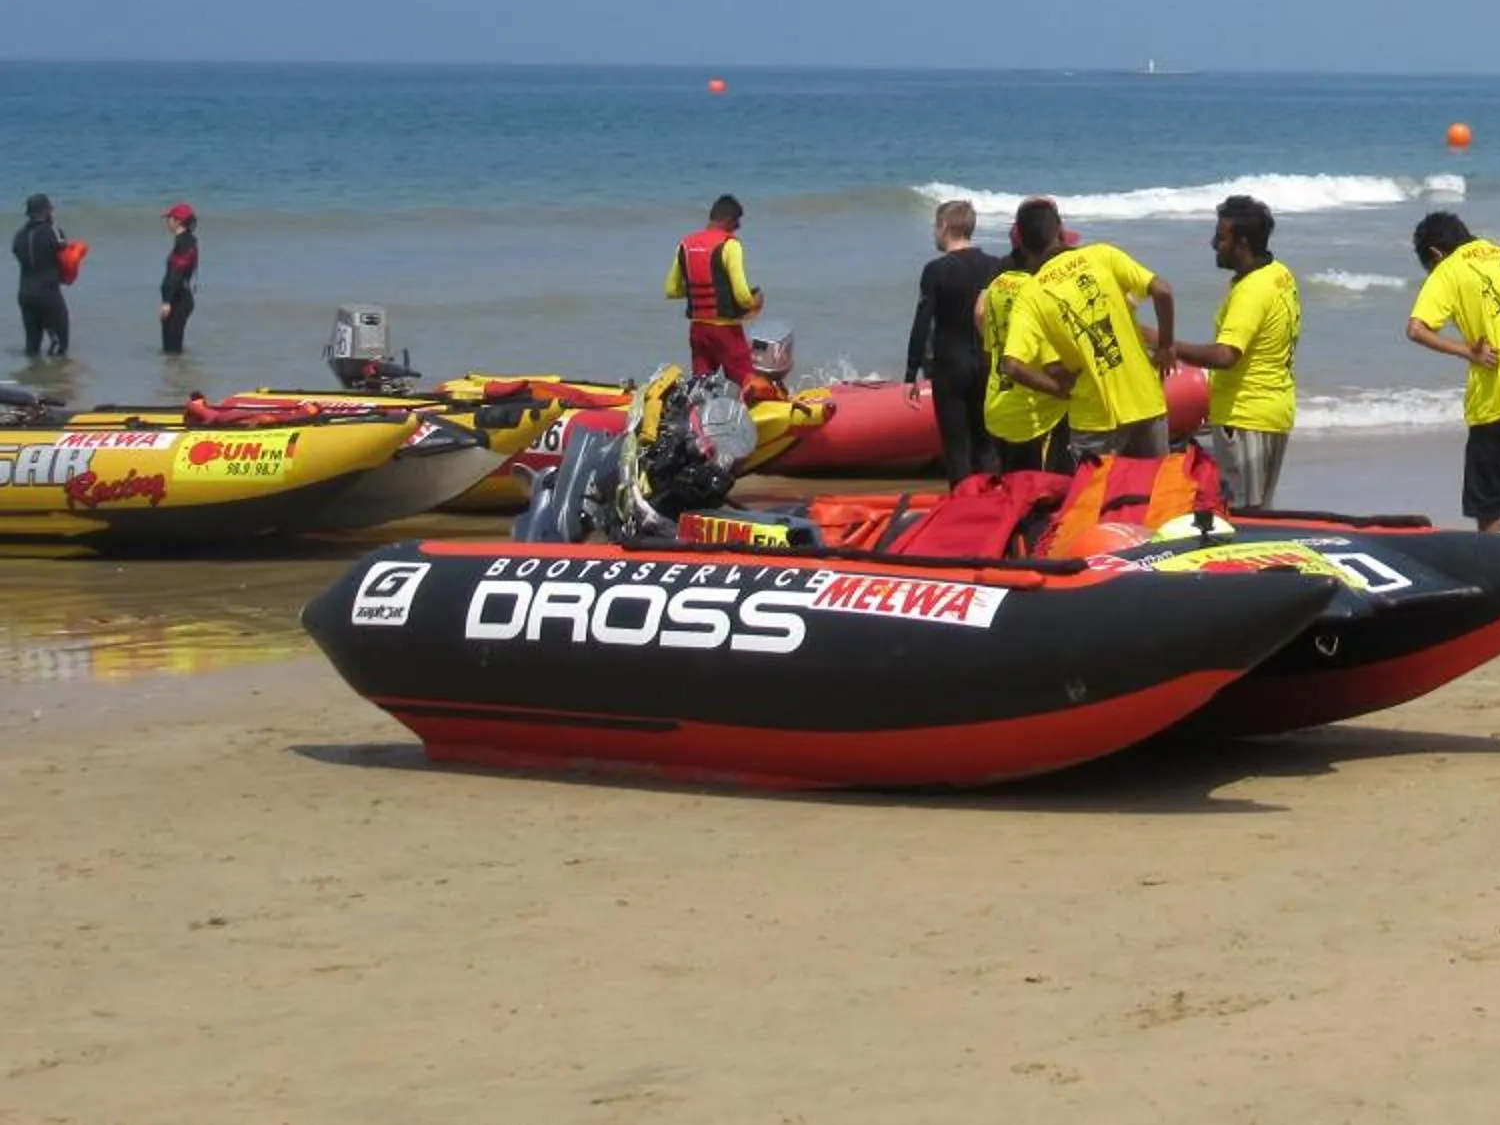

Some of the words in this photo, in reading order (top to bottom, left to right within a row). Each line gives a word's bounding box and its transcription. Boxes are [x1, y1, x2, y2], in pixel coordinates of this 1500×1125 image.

[1039, 255, 1088, 285] MELWA
[60, 431, 158, 448] MELWA
[260, 449, 283, 460] FM
[64, 468, 167, 511] Racing
[464, 579, 812, 654] DROSS
[812, 575, 978, 622] MELWA
